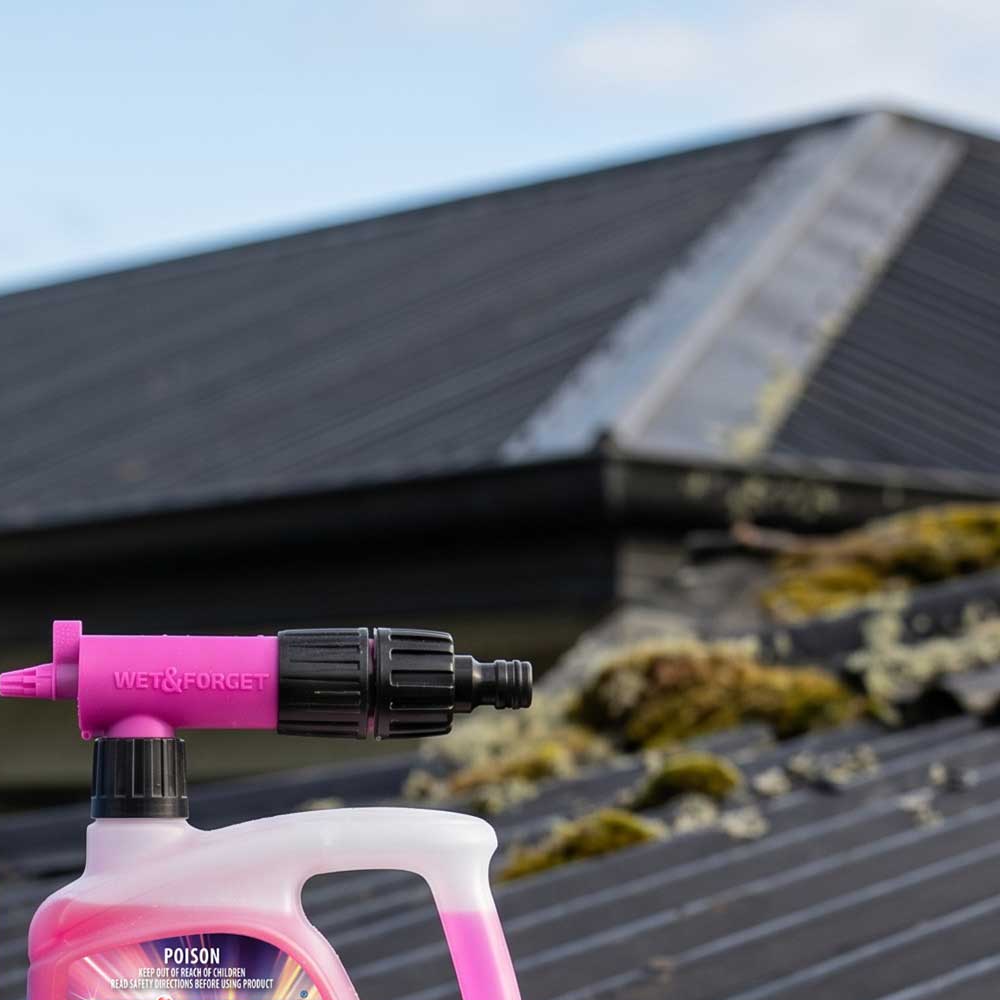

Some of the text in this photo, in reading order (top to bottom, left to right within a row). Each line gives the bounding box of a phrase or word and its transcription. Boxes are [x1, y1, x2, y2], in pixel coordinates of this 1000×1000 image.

[114, 667, 269, 694] WET&FORGET
[164, 948, 220, 964] POISON
[139, 968, 246, 977] KEEP OUT OF REACH OF CHILDREN
